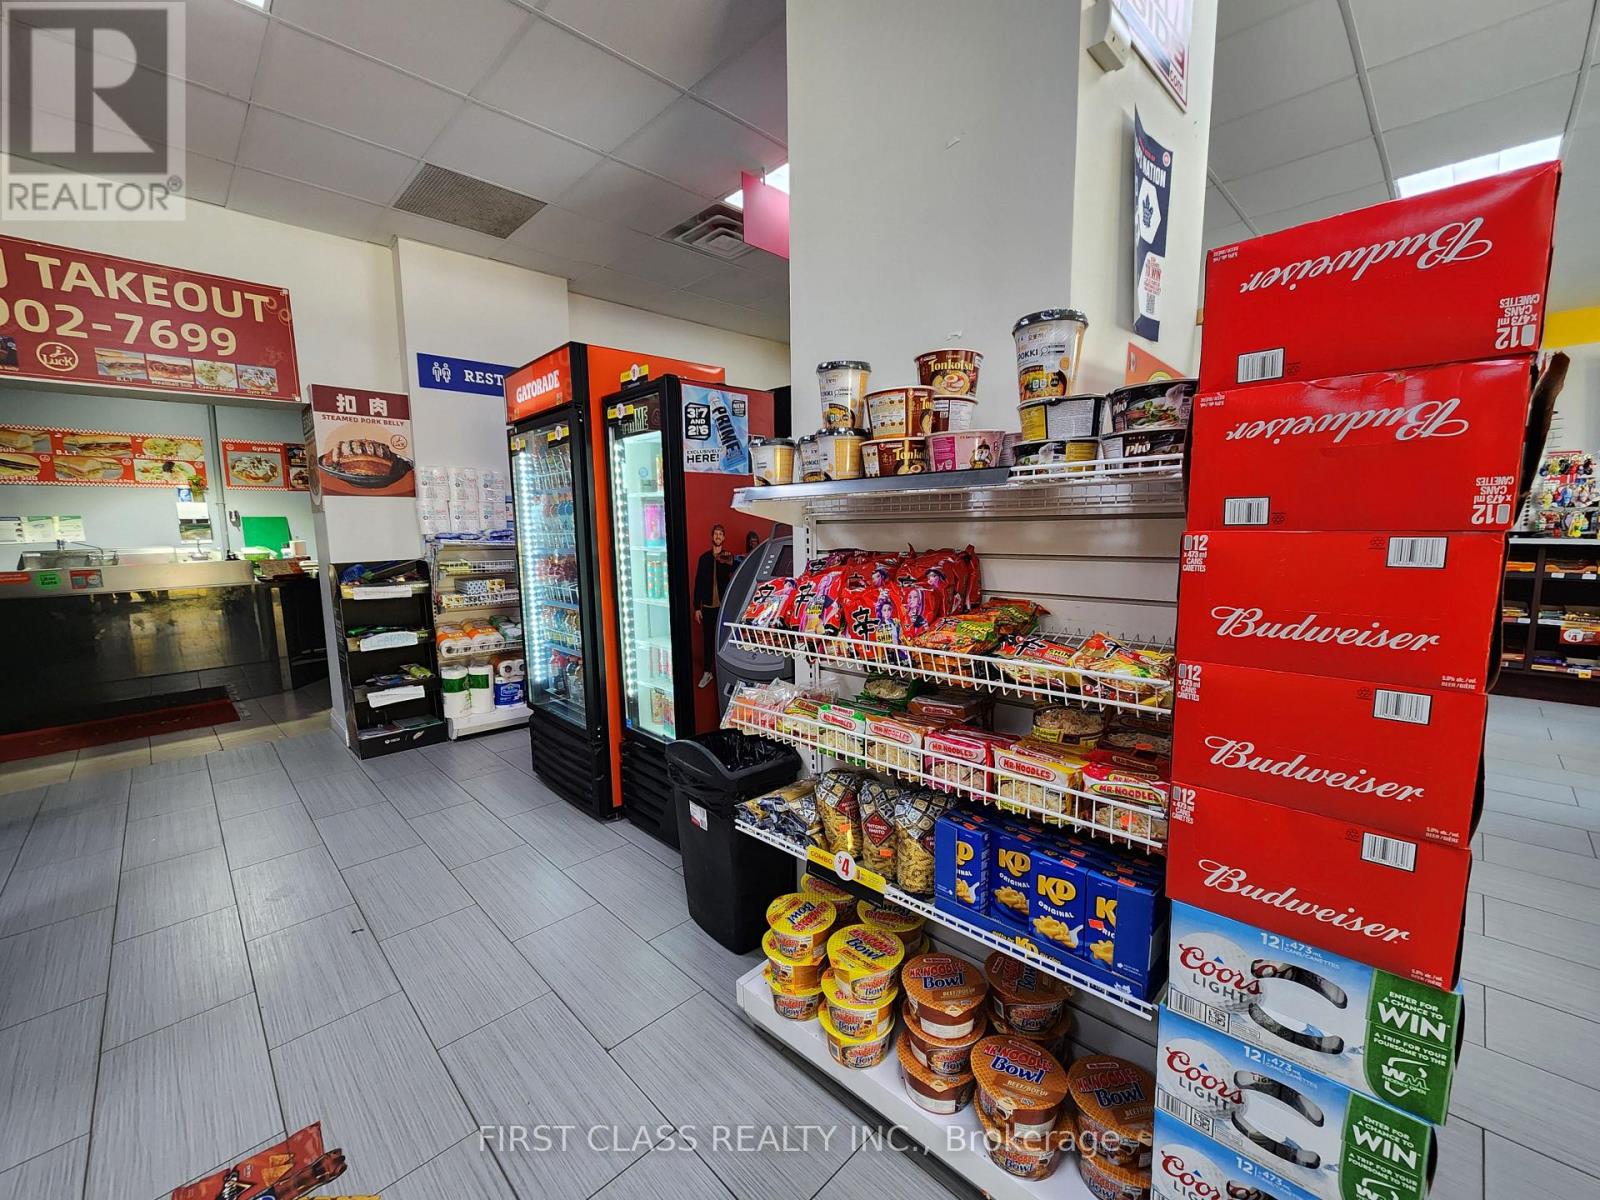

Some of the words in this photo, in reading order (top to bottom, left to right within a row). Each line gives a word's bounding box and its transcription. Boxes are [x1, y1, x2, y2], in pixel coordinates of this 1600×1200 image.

[1142, 155, 1167, 188] NATION
[1240, 217, 1493, 293] Budweiser
[25, 253, 270, 323] TAKEOUT
[1499, 293, 1540, 308] CANETTES
[1504, 304, 1533, 317] CANS
[0, 297, 237, 356] 02-7699
[1495, 326, 1519, 349] 12
[929, 359, 974, 372] Tonkotsu
[516, 370, 560, 403] GATORADE
[322, 414, 359, 423] STEAMED
[360, 417, 382, 425] PORK
[1225, 398, 1469, 444] Budweiser
[712, 404, 743, 461] PRIME
[687, 454, 720, 463] HERE!
[1476, 476, 1514, 486] CANETTES
[1480, 485, 1507, 495] CANS
[1471, 504, 1494, 525] 12
[1193, 534, 1209, 551] 12
[1183, 564, 1206, 572] CANETTES
[1186, 557, 1203, 565] CANS
[1211, 606, 1440, 652] Budweiser
[1188, 664, 1202, 681] 12
[1177, 691, 1200, 701] CANETTES
[1180, 686, 1197, 694] CANS
[1204, 736, 1425, 802] Budweiser
[1182, 787, 1196, 806] 12
[1172, 812, 1194, 824] CANETTES
[1175, 807, 1191, 815] CANS
[810, 850, 833, 866] COMBO
[998, 848, 1031, 877] KD
[999, 872, 1031, 888] ORIGINAL
[1037, 874, 1077, 906] KD
[787, 901, 817, 925] Bowl
[1038, 901, 1075, 919] ORIGINAL
[1096, 896, 1117, 927] K
[1198, 859, 1410, 944] Budweiser
[846, 937, 886, 960] Bowl
[1260, 932, 1280, 949] 12
[1178, 943, 1262, 995] Coors
[923, 973, 965, 989] Bowl
[1192, 974, 1247, 1004] LIGHT
[1390, 991, 1418, 1006] ENTER
[1420, 1001, 1438, 1012] FOR
[1391, 999, 1429, 1016] CHANCE
[1431, 1011, 1444, 1020] TO
[838, 1021, 861, 1032] Bowl
[1378, 1001, 1447, 1042] WIN
[1243, 1045, 1261, 1063] 12
[1373, 1037, 1417, 1057] FOURSOME
[1418, 1053, 1430, 1061] TO
[1430, 1057, 1447, 1066] THE
[1382, 1034, 1402, 1045] TRIP
[1403, 1041, 1421, 1052] FOR
[1423, 1048, 1447, 1060] YOUR
[991, 1056, 1046, 1084] Bowl
[1165, 1045, 1244, 1105] Coors
[1094, 1081, 1145, 1108] Bowl
[1179, 1075, 1228, 1111] LIGHT
[1409, 1085, 1427, 1096] OPEN
[1363, 1115, 1390, 1132] ENTER
[1391, 1128, 1410, 1140] FOR
[1364, 1123, 1400, 1143] CHANCE
[1402, 1139, 1414, 1149] TO
[1352, 1124, 1417, 1170] WIN
[1005, 1160, 1034, 1172] Bowl
[1236, 1156, 1253, 1175] 12
[1348, 1157, 1389, 1180] FOURSOME
[1390, 1176, 1400, 1185] TO
[1401, 1181, 1417, 1193] THE
[1356, 1155, 1374, 1166] TRIP
[1375, 1164, 1393, 1175] FOR
[1394, 1172, 1418, 1187] YOUR
